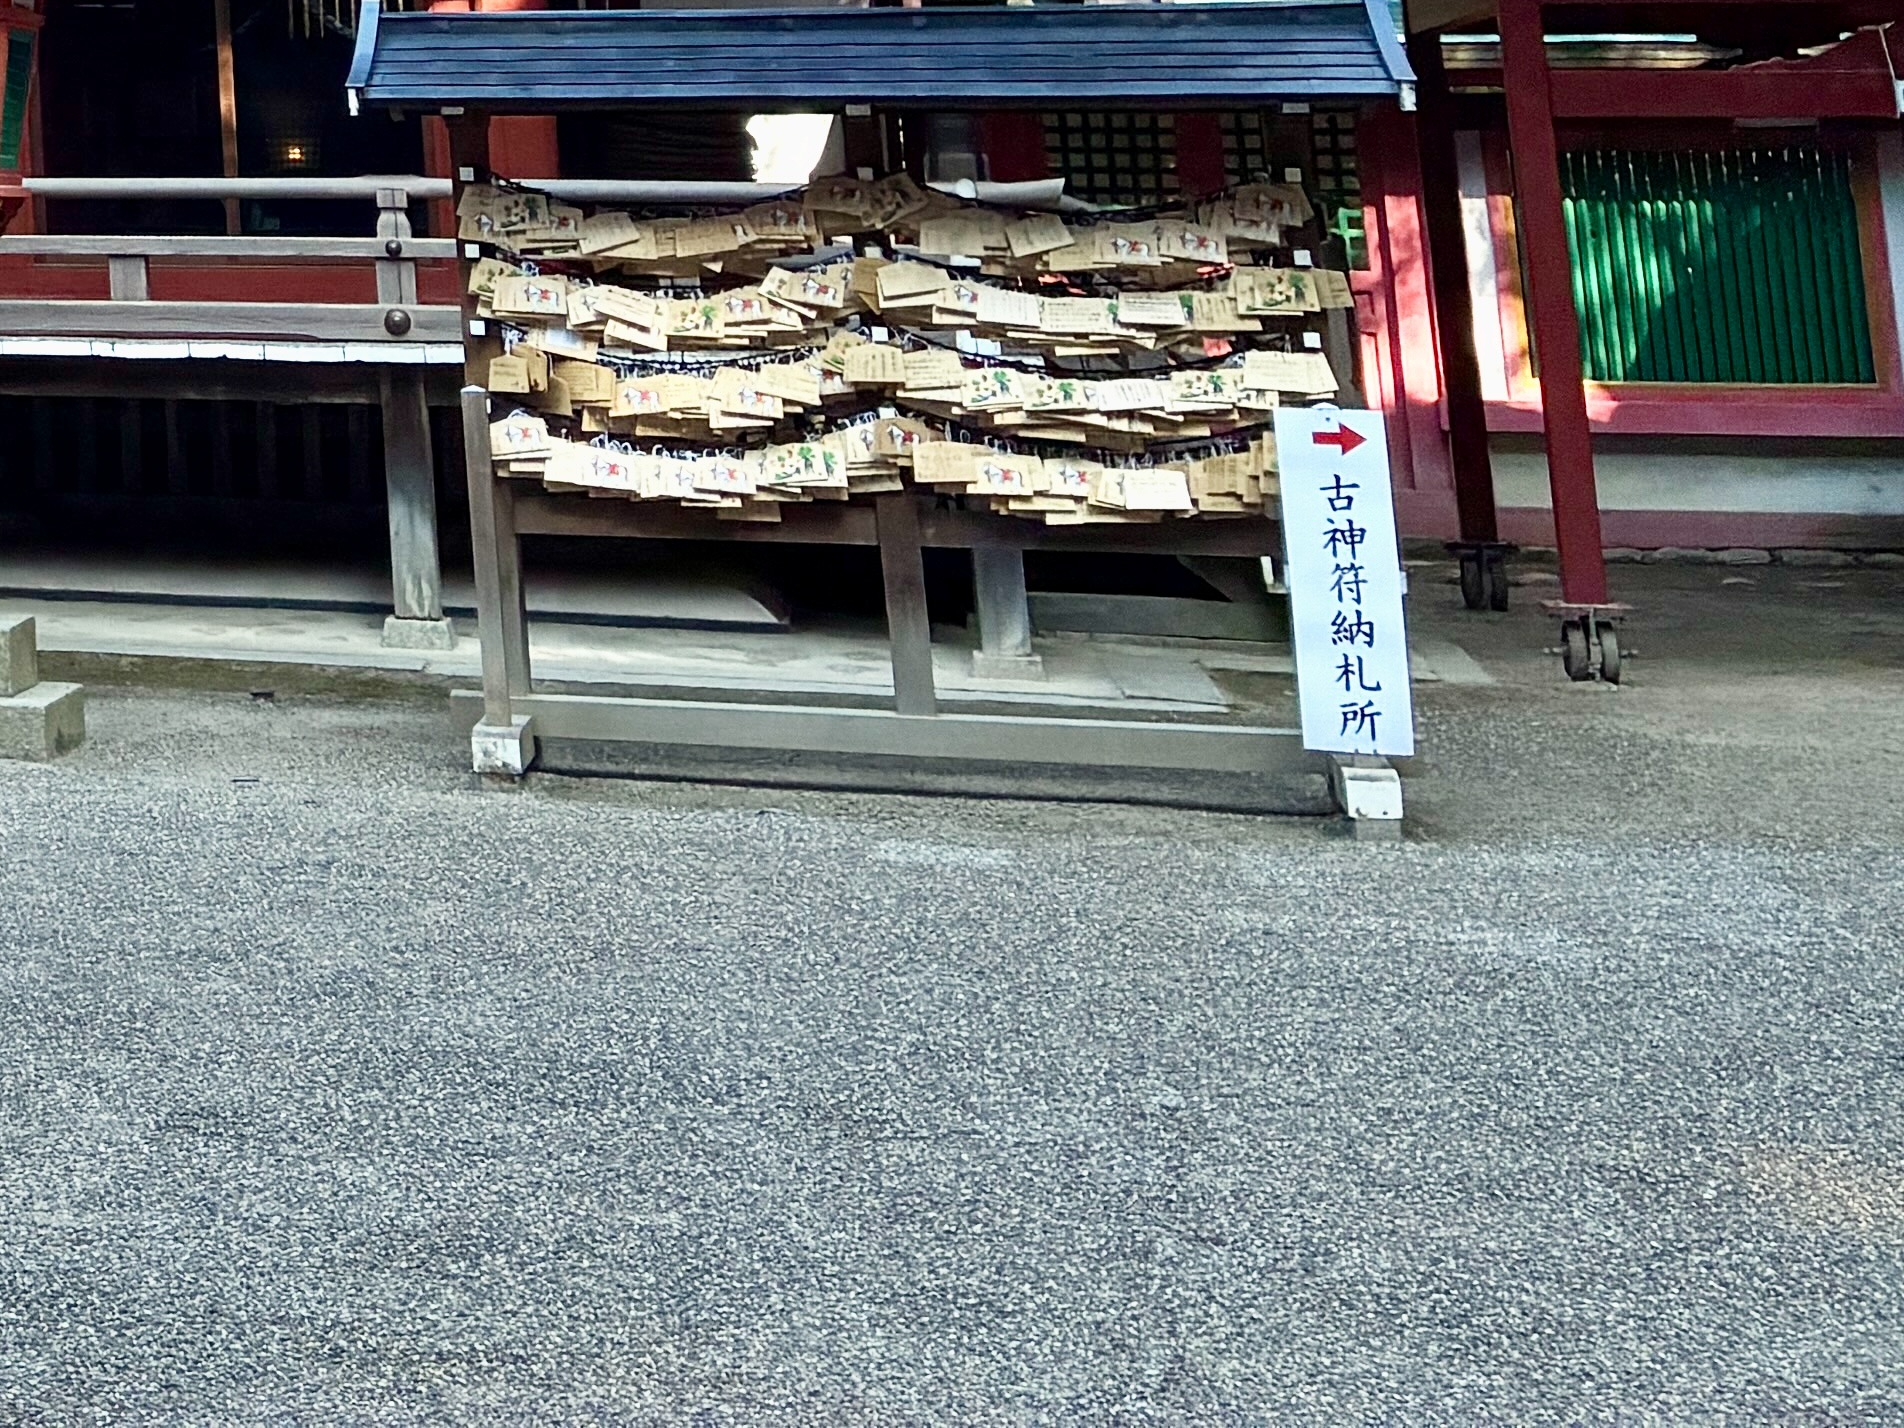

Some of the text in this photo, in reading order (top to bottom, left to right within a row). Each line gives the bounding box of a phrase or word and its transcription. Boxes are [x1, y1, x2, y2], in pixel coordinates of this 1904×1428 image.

[1319, 473, 1383, 742] 古神符納札所
